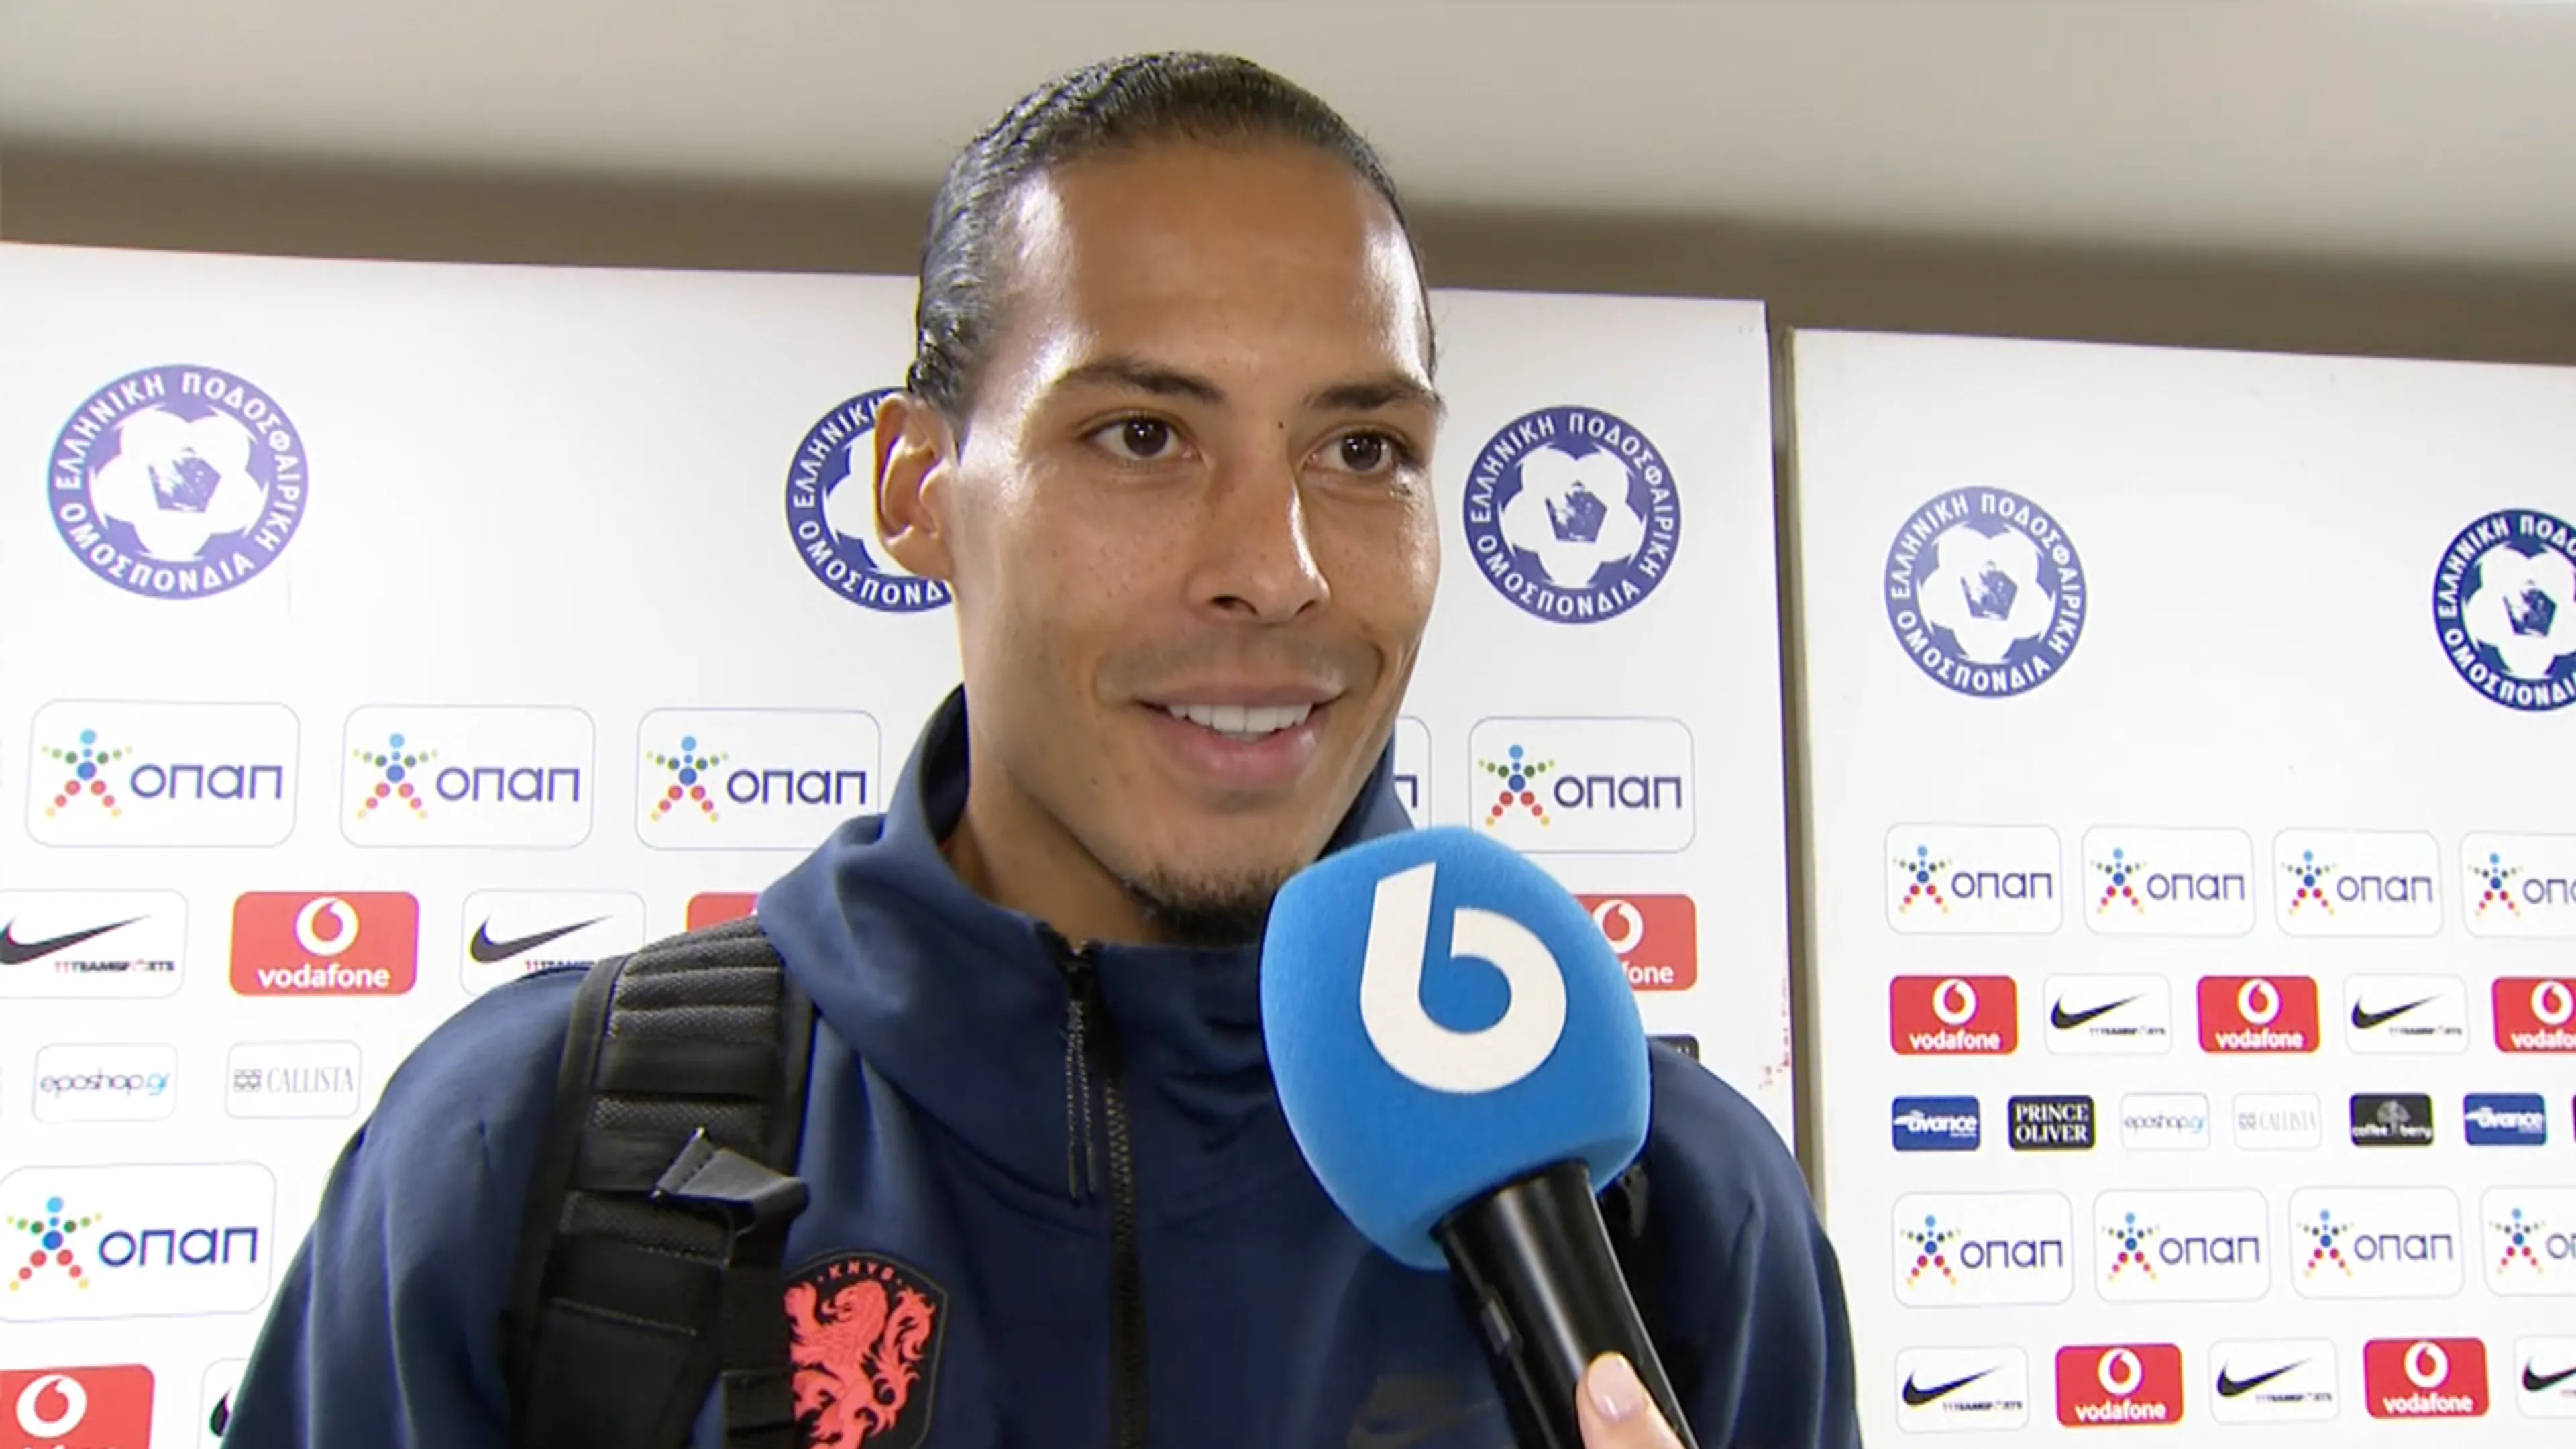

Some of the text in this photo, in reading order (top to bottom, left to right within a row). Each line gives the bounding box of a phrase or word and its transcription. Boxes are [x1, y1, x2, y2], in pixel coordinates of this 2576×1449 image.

[56, 373, 166, 489] ΕΛΛΗΝΙΚΗ
[1470, 415, 1555, 523] ΕΛΛΗΝΙΚΗ
[60, 502, 254, 592] ΟΜΟΣΠΟΝΔΙΑ
[1891, 494, 1969, 599] ΕΛΛΗΝΙΚΗ
[798, 520, 943, 605] ΟΜΟΣΠΟΝΔ
[1477, 535, 1640, 617] ΟΜΟΣΠΟΝΔΙΑ
[2444, 628, 2576, 706] ΟΜΟΣΠΟΝΔΙ
[2523, 878, 2576, 904] οπ
[258, 963, 390, 988] vodafone
[1621, 960, 1674, 984] fone
[1909, 1030, 2001, 1051] vodafone
[2215, 1028, 2304, 1049] vodafone
[2510, 1028, 2576, 1050] vodafo
[266, 1067, 354, 1094] CALLISTA
[2015, 1103, 2088, 1122] PRINCE
[2015, 1123, 2088, 1143] OLIVER
[2076, 1400, 2167, 1422] vodafone
[2383, 1393, 2473, 1414] vodafone
